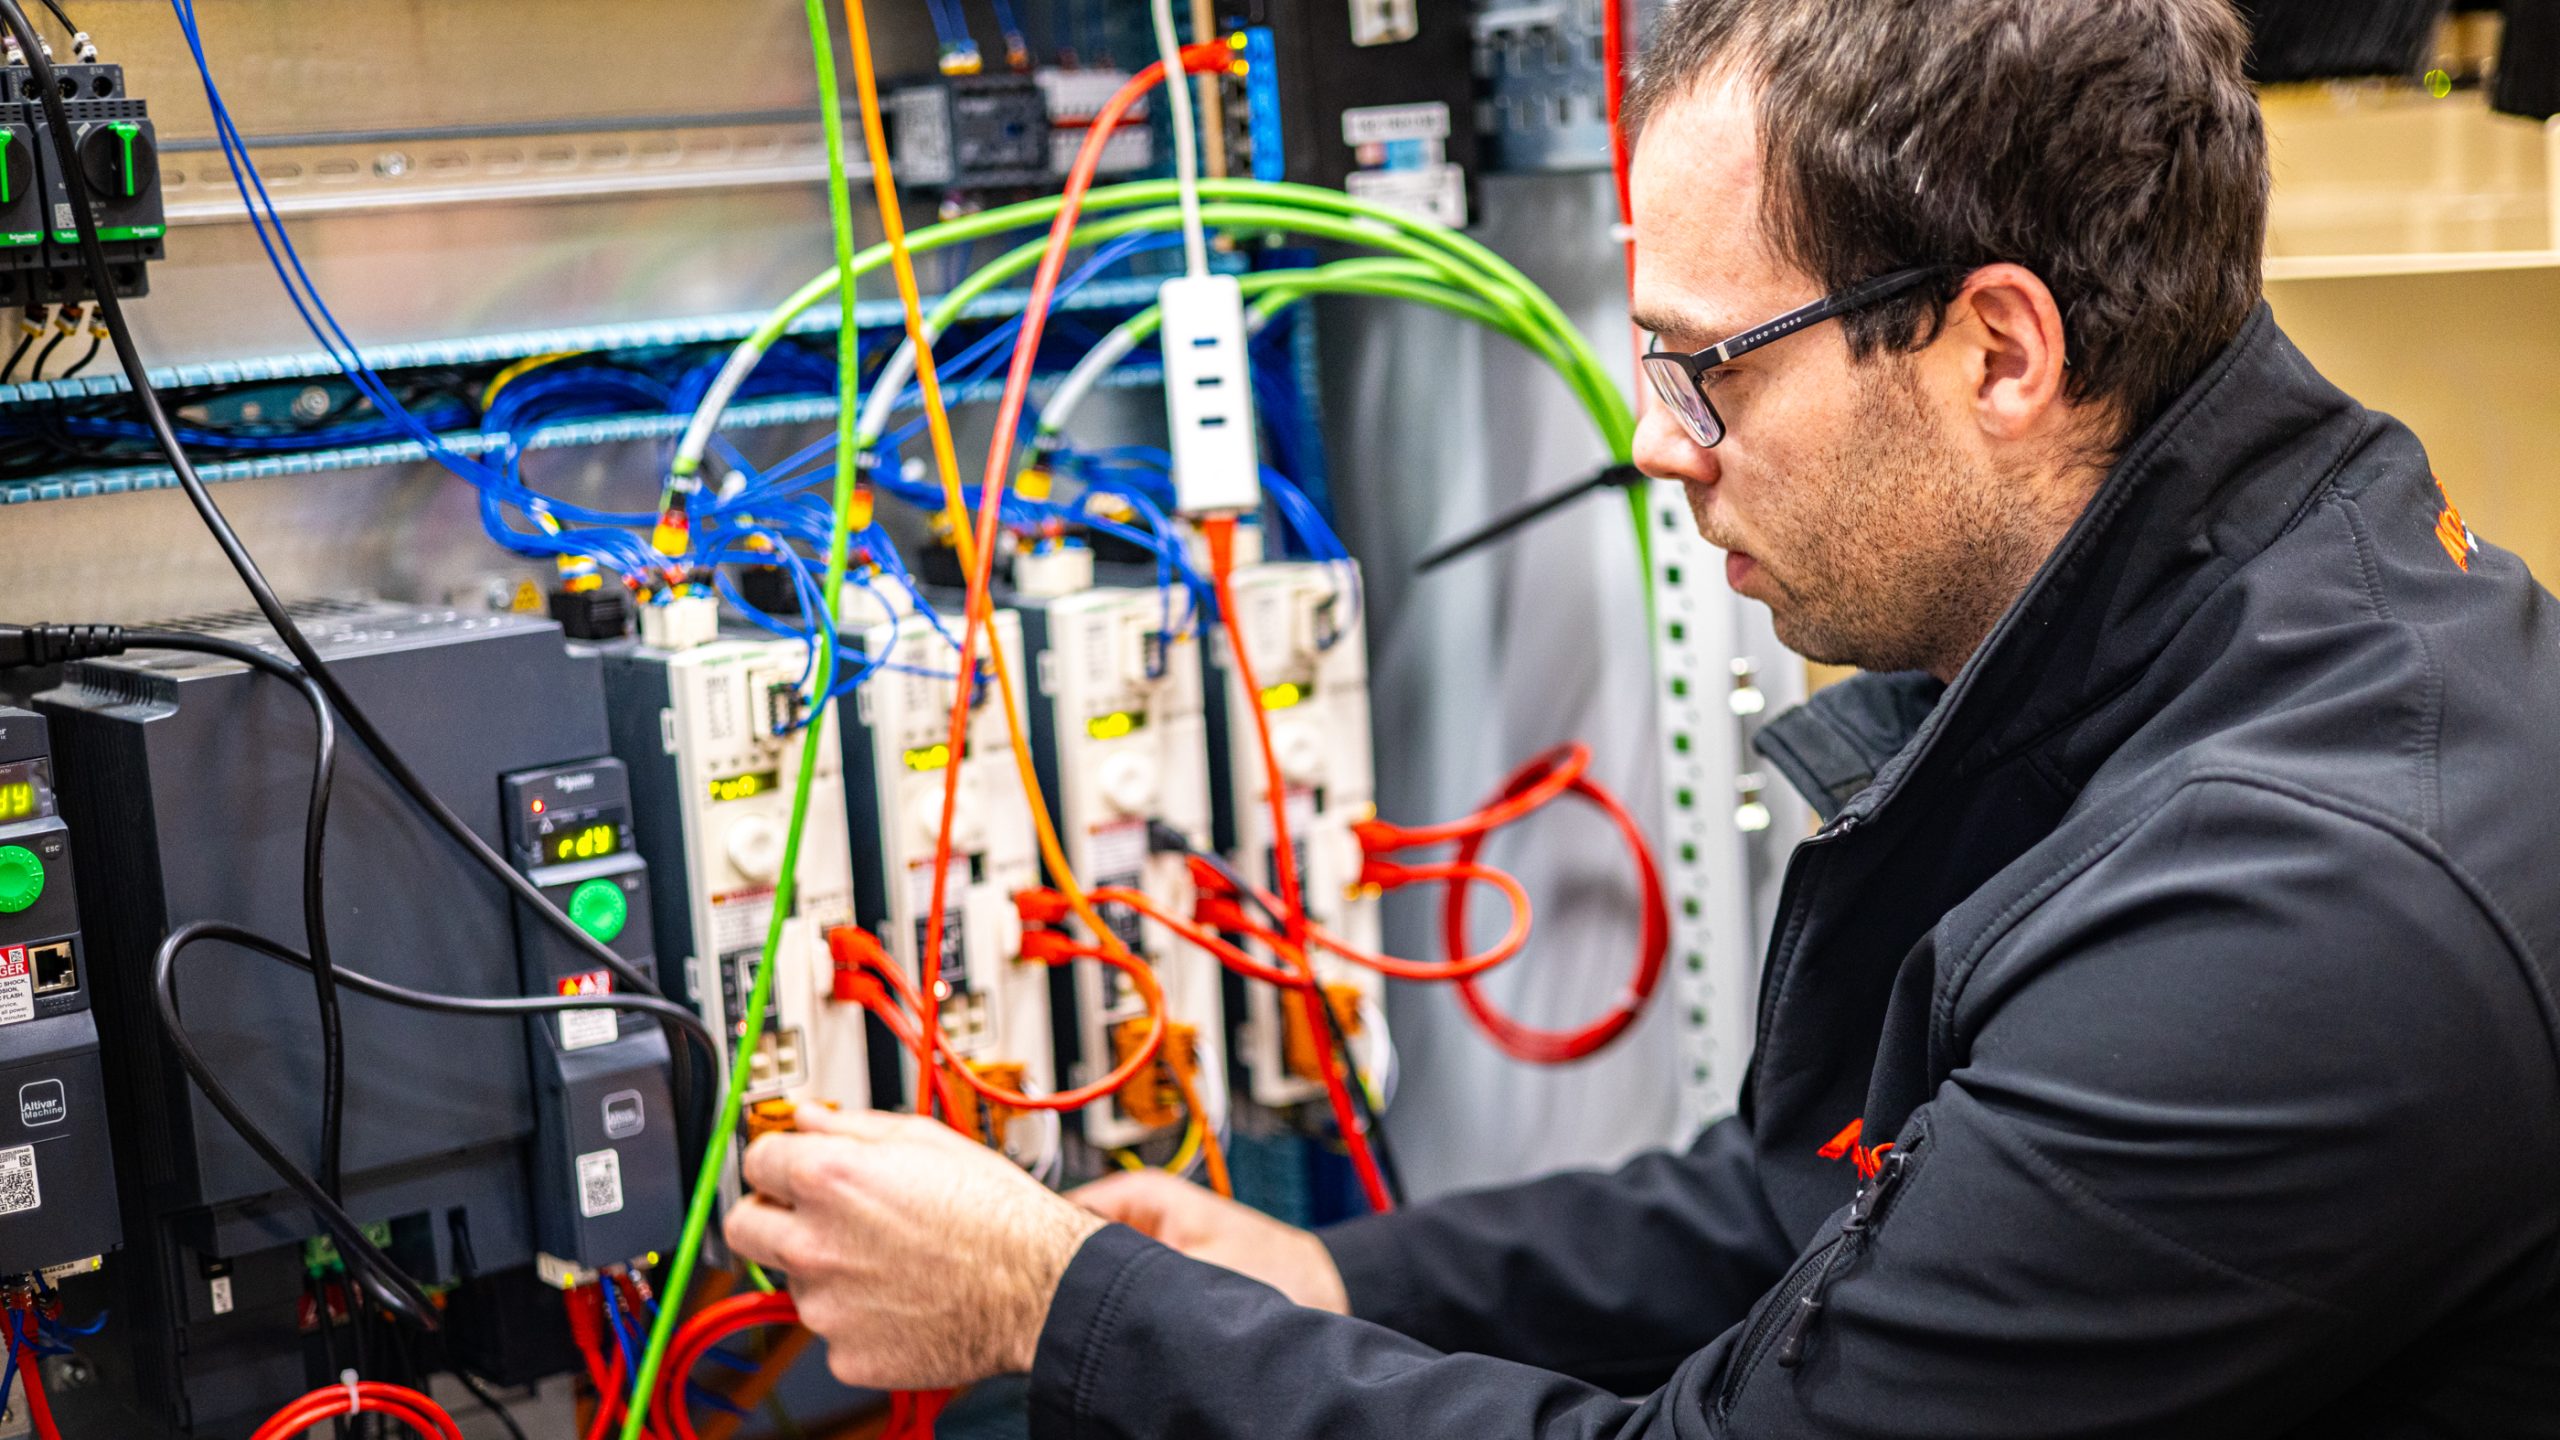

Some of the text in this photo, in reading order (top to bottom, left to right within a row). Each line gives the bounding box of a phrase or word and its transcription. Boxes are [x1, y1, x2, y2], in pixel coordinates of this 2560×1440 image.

[1741, 316, 1802, 346] HUGO BOSS
[45, 845, 60, 853] ESC
[23, 1099, 57, 1112] Altivar
[24, 1106, 63, 1119] Machine
